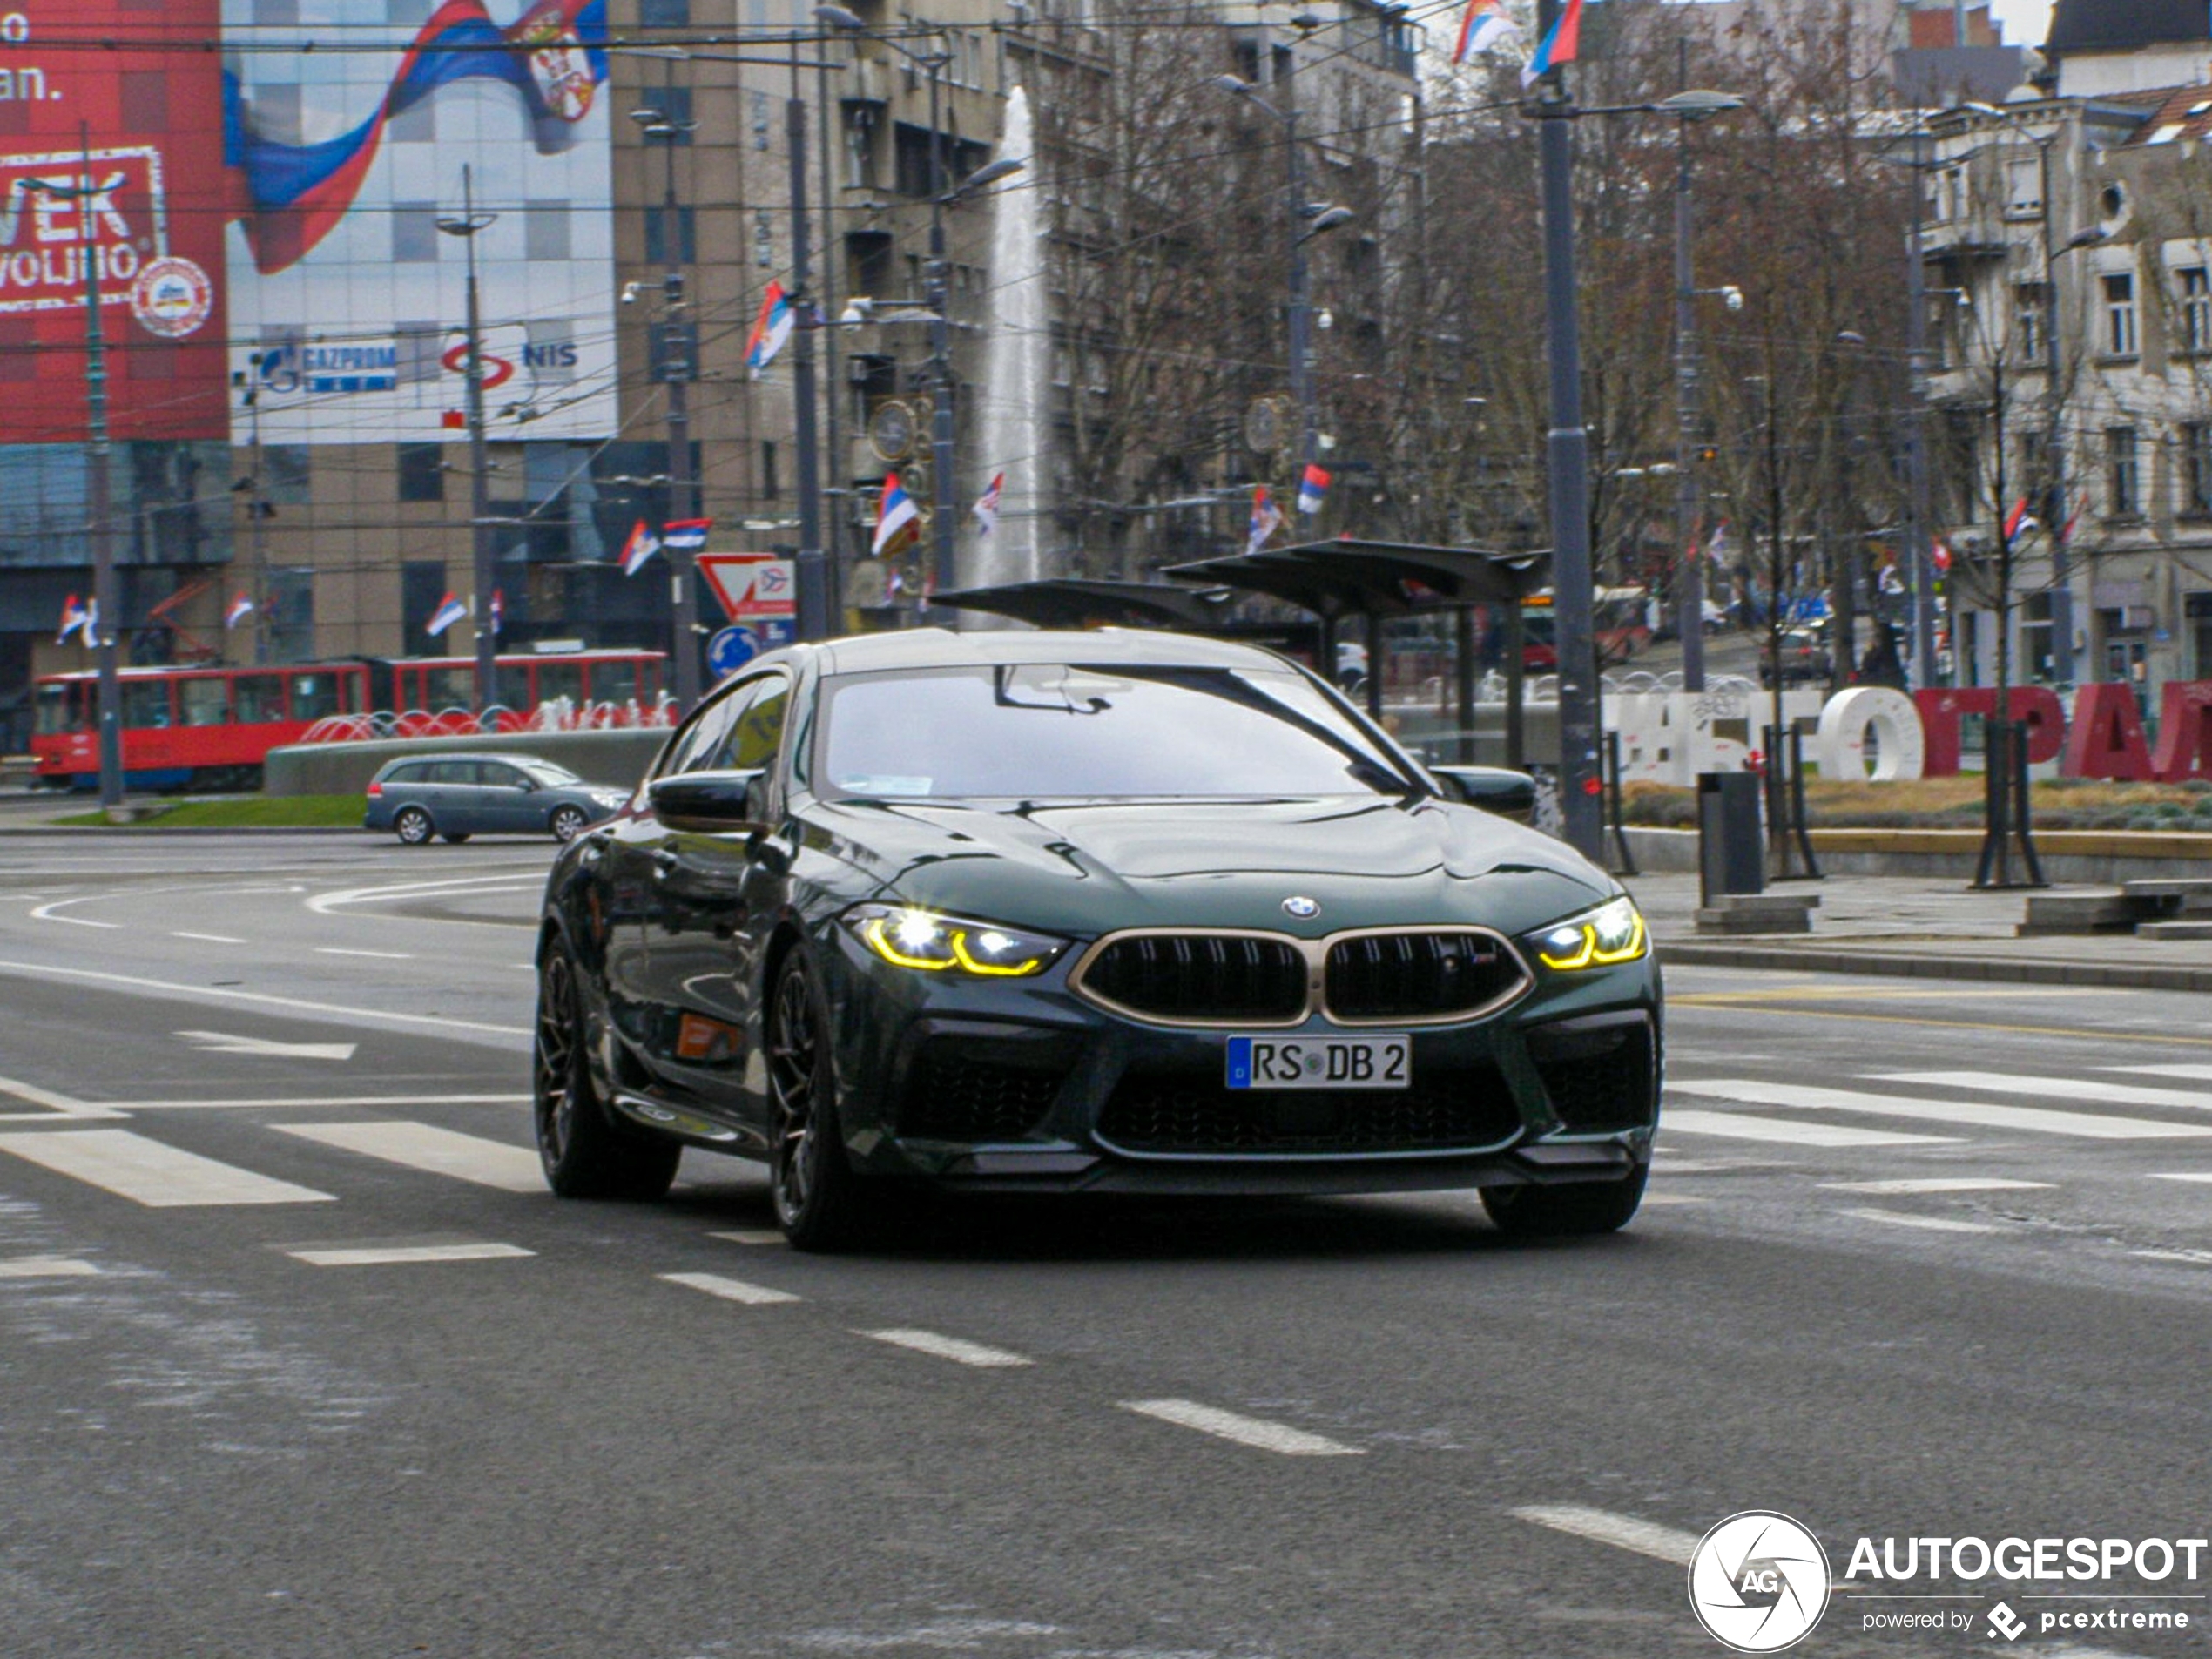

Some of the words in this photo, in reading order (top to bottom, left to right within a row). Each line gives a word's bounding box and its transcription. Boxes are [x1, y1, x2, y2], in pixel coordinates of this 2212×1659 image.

[523, 343, 577, 368] NIS
[1252, 1044, 1303, 1080] RS
[1326, 1045, 1373, 1081] DB
[1384, 1045, 1405, 1081] 2
